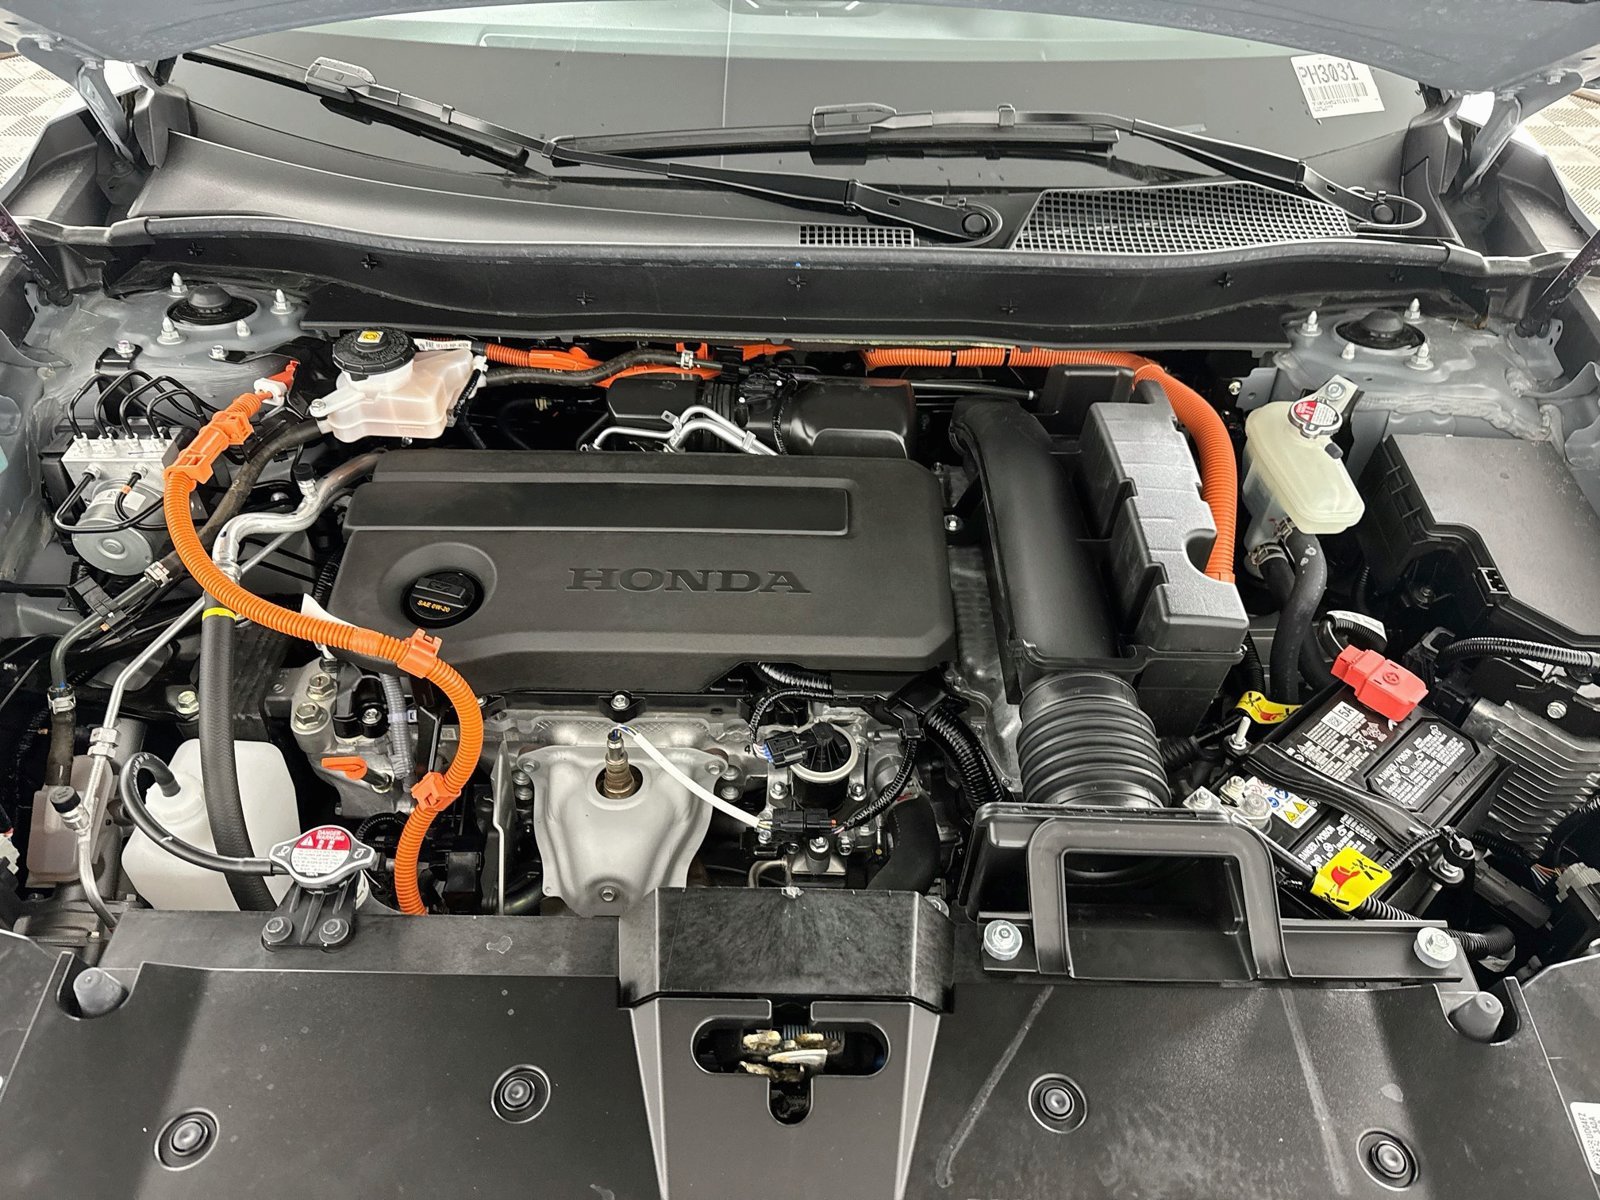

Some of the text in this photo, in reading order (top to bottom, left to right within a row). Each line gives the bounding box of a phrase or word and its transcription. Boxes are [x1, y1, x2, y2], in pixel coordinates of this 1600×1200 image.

[1297, 62, 1359, 85] PH3031
[565, 567, 812, 595] HONDA
[416, 599, 451, 613] SAE 0W-20
[1342, 706, 1355, 718] 5A
